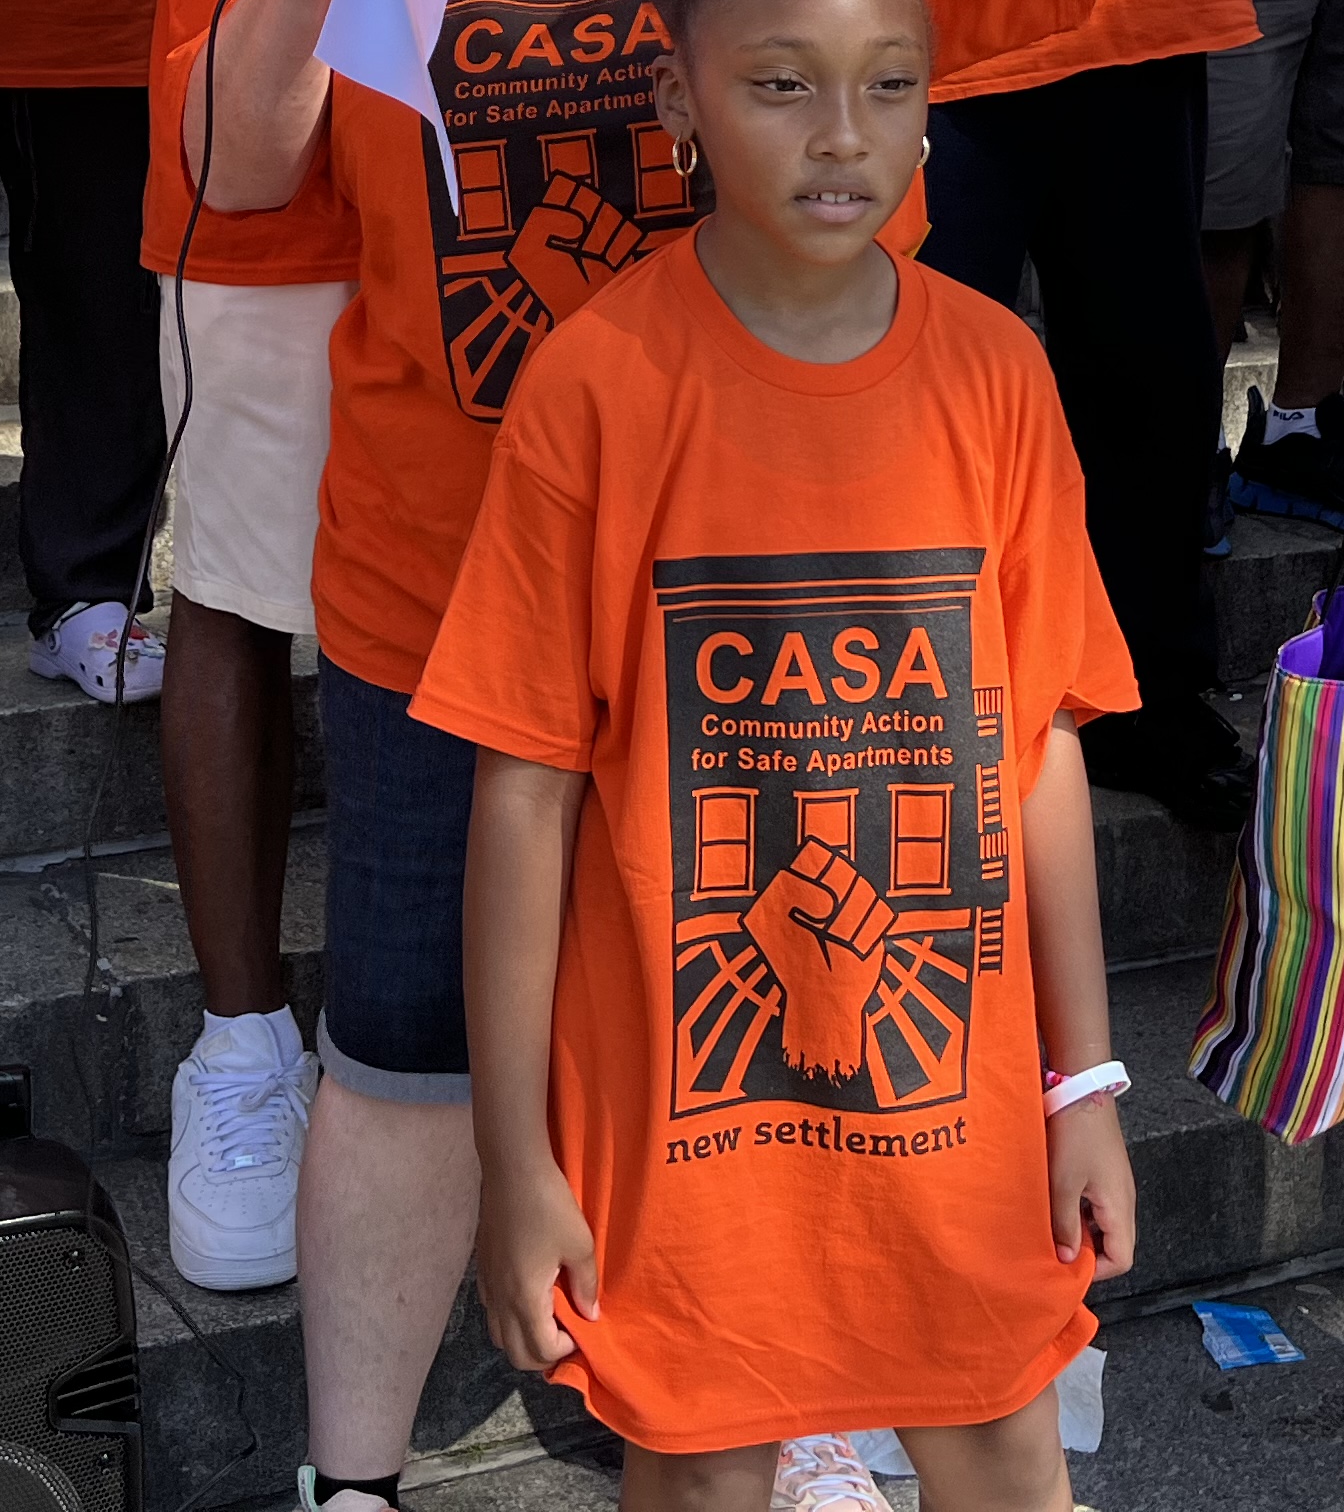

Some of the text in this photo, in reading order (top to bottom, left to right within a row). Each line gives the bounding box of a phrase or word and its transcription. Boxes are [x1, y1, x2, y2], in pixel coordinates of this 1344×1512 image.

[453, 1, 675, 74] CASA
[455, 72, 589, 100] Community
[444, 109, 478, 128] for
[486, 102, 538, 124] Safe
[694, 626, 948, 705] CASA
[700, 710, 945, 743] Community Action
[691, 742, 954, 779] for Safe Apartments
[665, 1113, 969, 1166] new settlement
